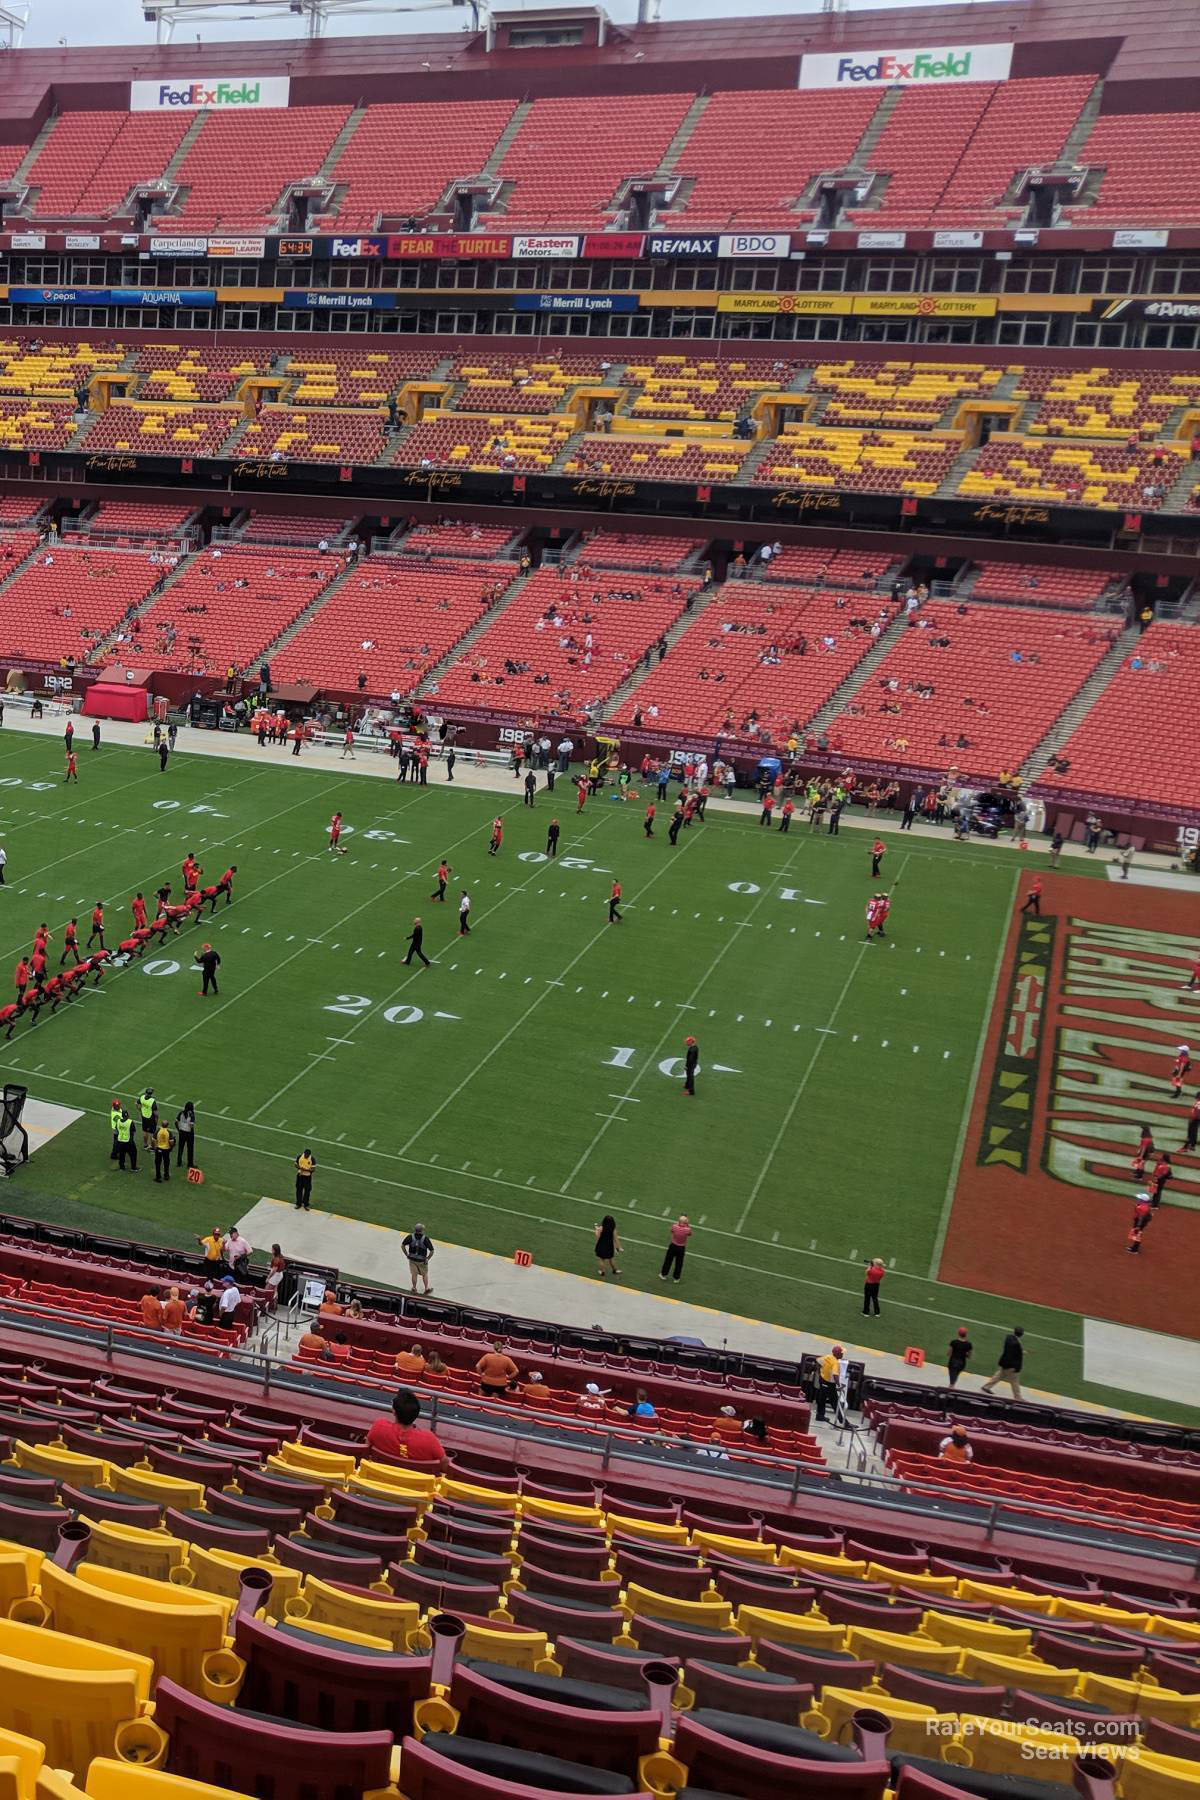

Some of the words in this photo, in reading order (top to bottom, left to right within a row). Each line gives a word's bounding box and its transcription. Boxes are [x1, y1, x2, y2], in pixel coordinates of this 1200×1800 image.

[837, 52, 971, 81] FedExField
[159, 82, 260, 105] FedExField
[332, 239, 381, 257] FedEx
[528, 239, 574, 248] Eastern
[651, 240, 714, 253] RE/MAX
[736, 237, 777, 252] BDO
[54, 292, 76, 302] pepsi
[142, 292, 182, 304] AQUAFINA
[318, 296, 346, 305] Merrill
[347, 296, 373, 307] Lynch
[552, 298, 584, 308] Merrill
[585, 298, 613, 310] Lynch
[734, 299, 778, 308] MARYLAND
[797, 300, 834, 310] LOTTERY
[870, 301, 918, 310] MARYLAND
[936, 302, 977, 312] LOTTERY
[323, 994, 424, 1024] 20
[601, 1046, 701, 1078] 10
[189, 1168, 200, 1183] 20
[517, 1252, 530, 1266] 10
[908, 1350, 920, 1364] G
